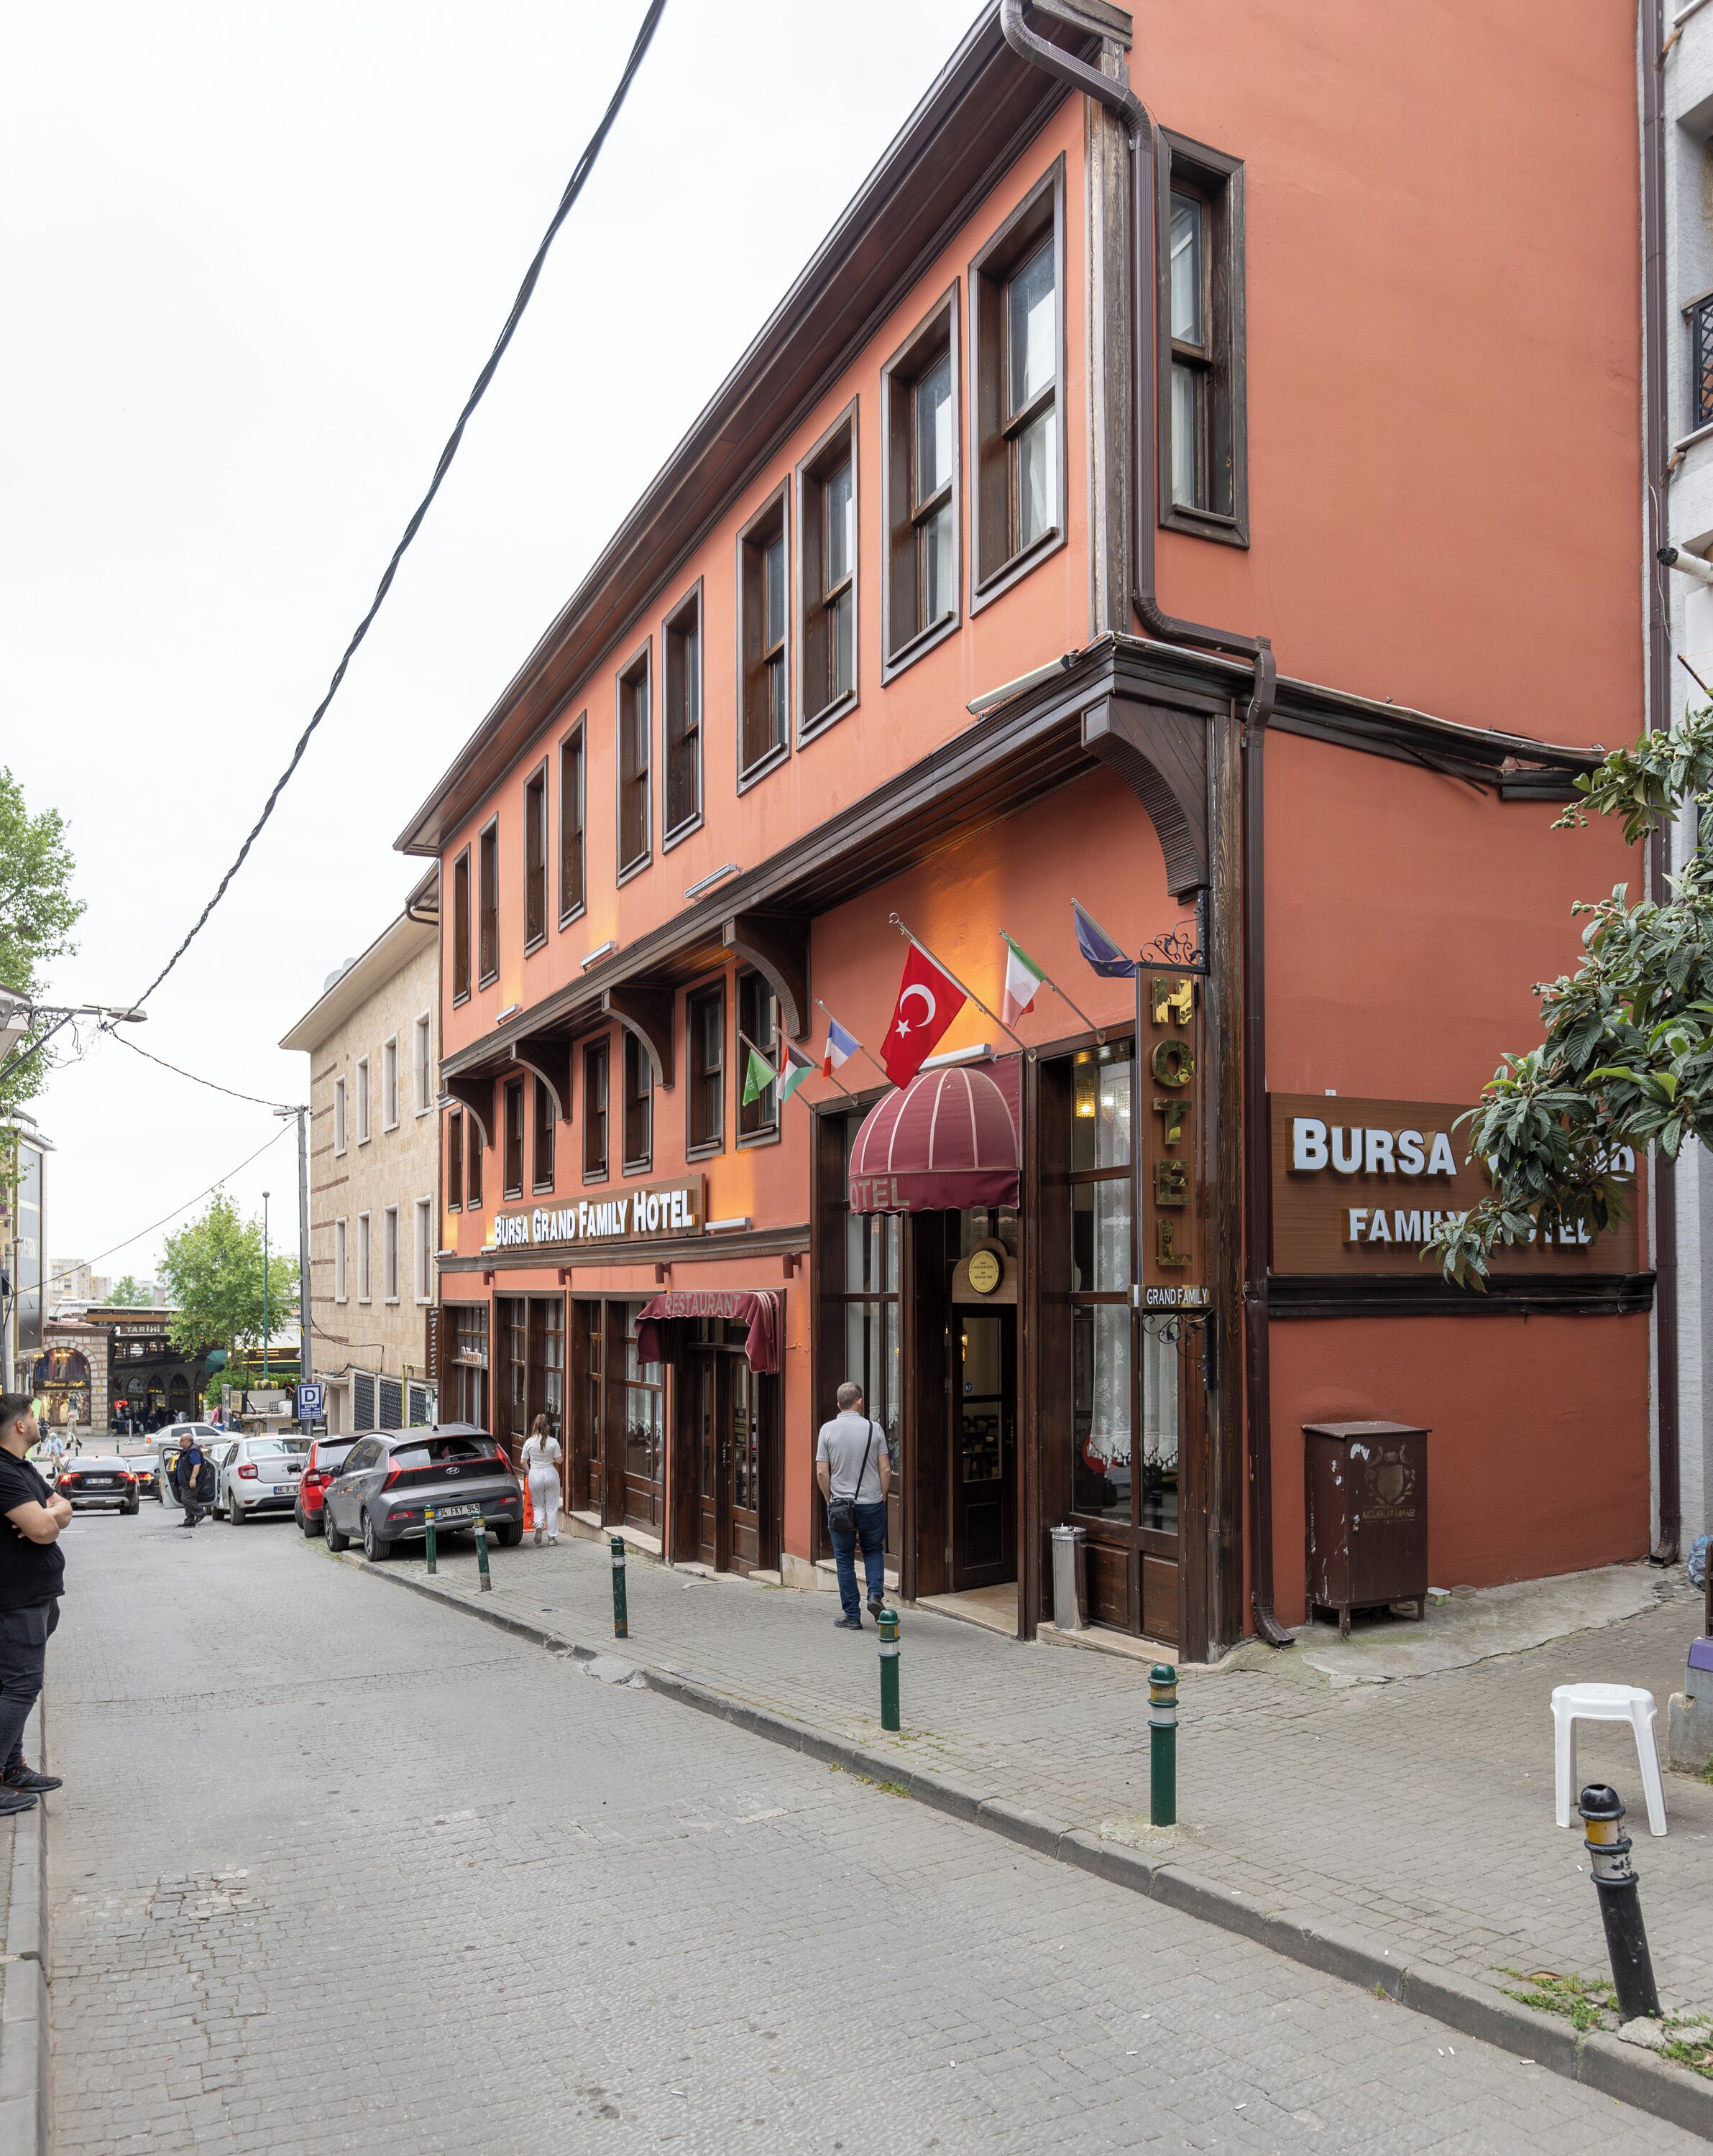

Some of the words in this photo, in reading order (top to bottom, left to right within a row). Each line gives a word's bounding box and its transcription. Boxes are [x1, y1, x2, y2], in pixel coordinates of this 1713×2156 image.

[1152, 977, 1194, 1265] HOTEL
[1292, 1116, 1458, 1176] BURSA
[495, 1215, 529, 1245] BURSA
[533, 1208, 575, 1243] GRAND
[579, 1200, 630, 1238] FAMILY
[633, 1189, 693, 1233] HOTEL
[665, 1294, 741, 1315] RESTAURANT
[1147, 1288, 1177, 1305] GRAND
[1177, 1287, 1208, 1304] FAMILY
[304, 1389, 316, 1402] D
[438, 1508, 447, 1517] 34
[450, 1506, 463, 1516] FKY
[467, 1503, 479, 1513] 949
